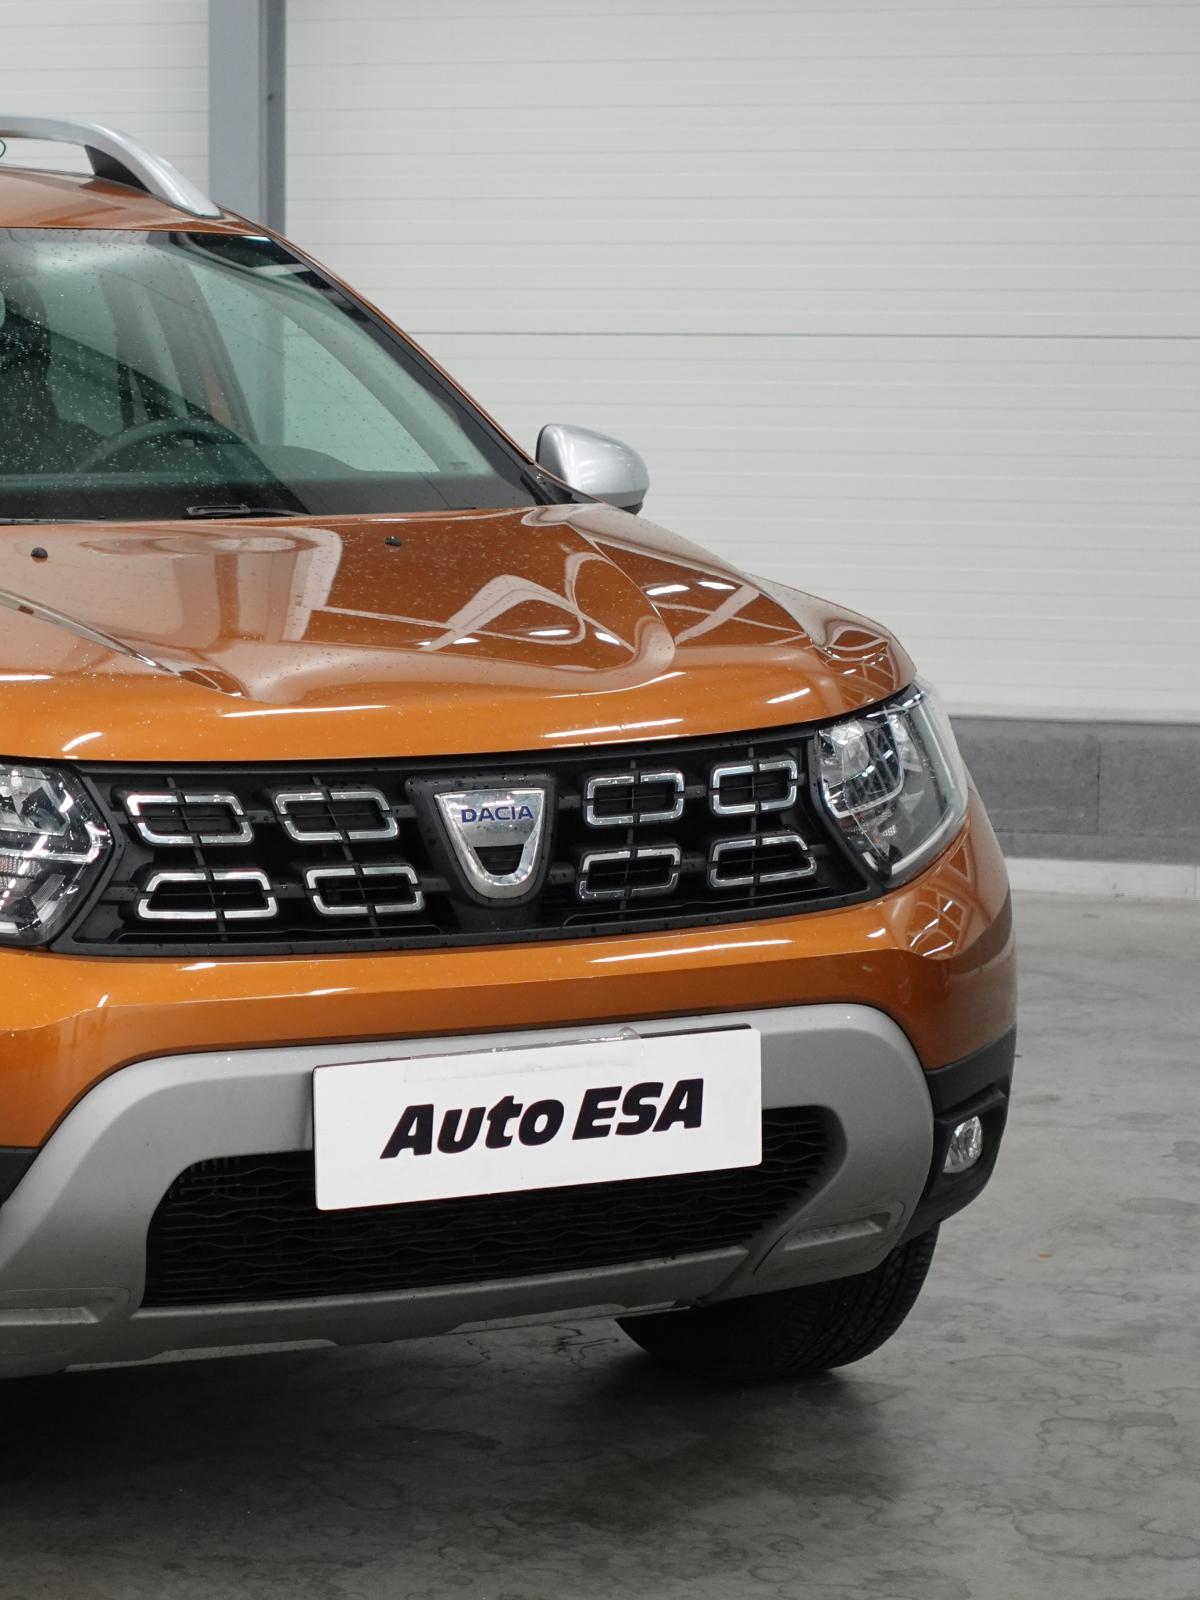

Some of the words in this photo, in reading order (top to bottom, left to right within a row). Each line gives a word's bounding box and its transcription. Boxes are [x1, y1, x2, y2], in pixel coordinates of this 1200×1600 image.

[461, 805, 533, 823] DACIA
[380, 1095, 565, 1159] Auto
[572, 1078, 704, 1141] ESA
